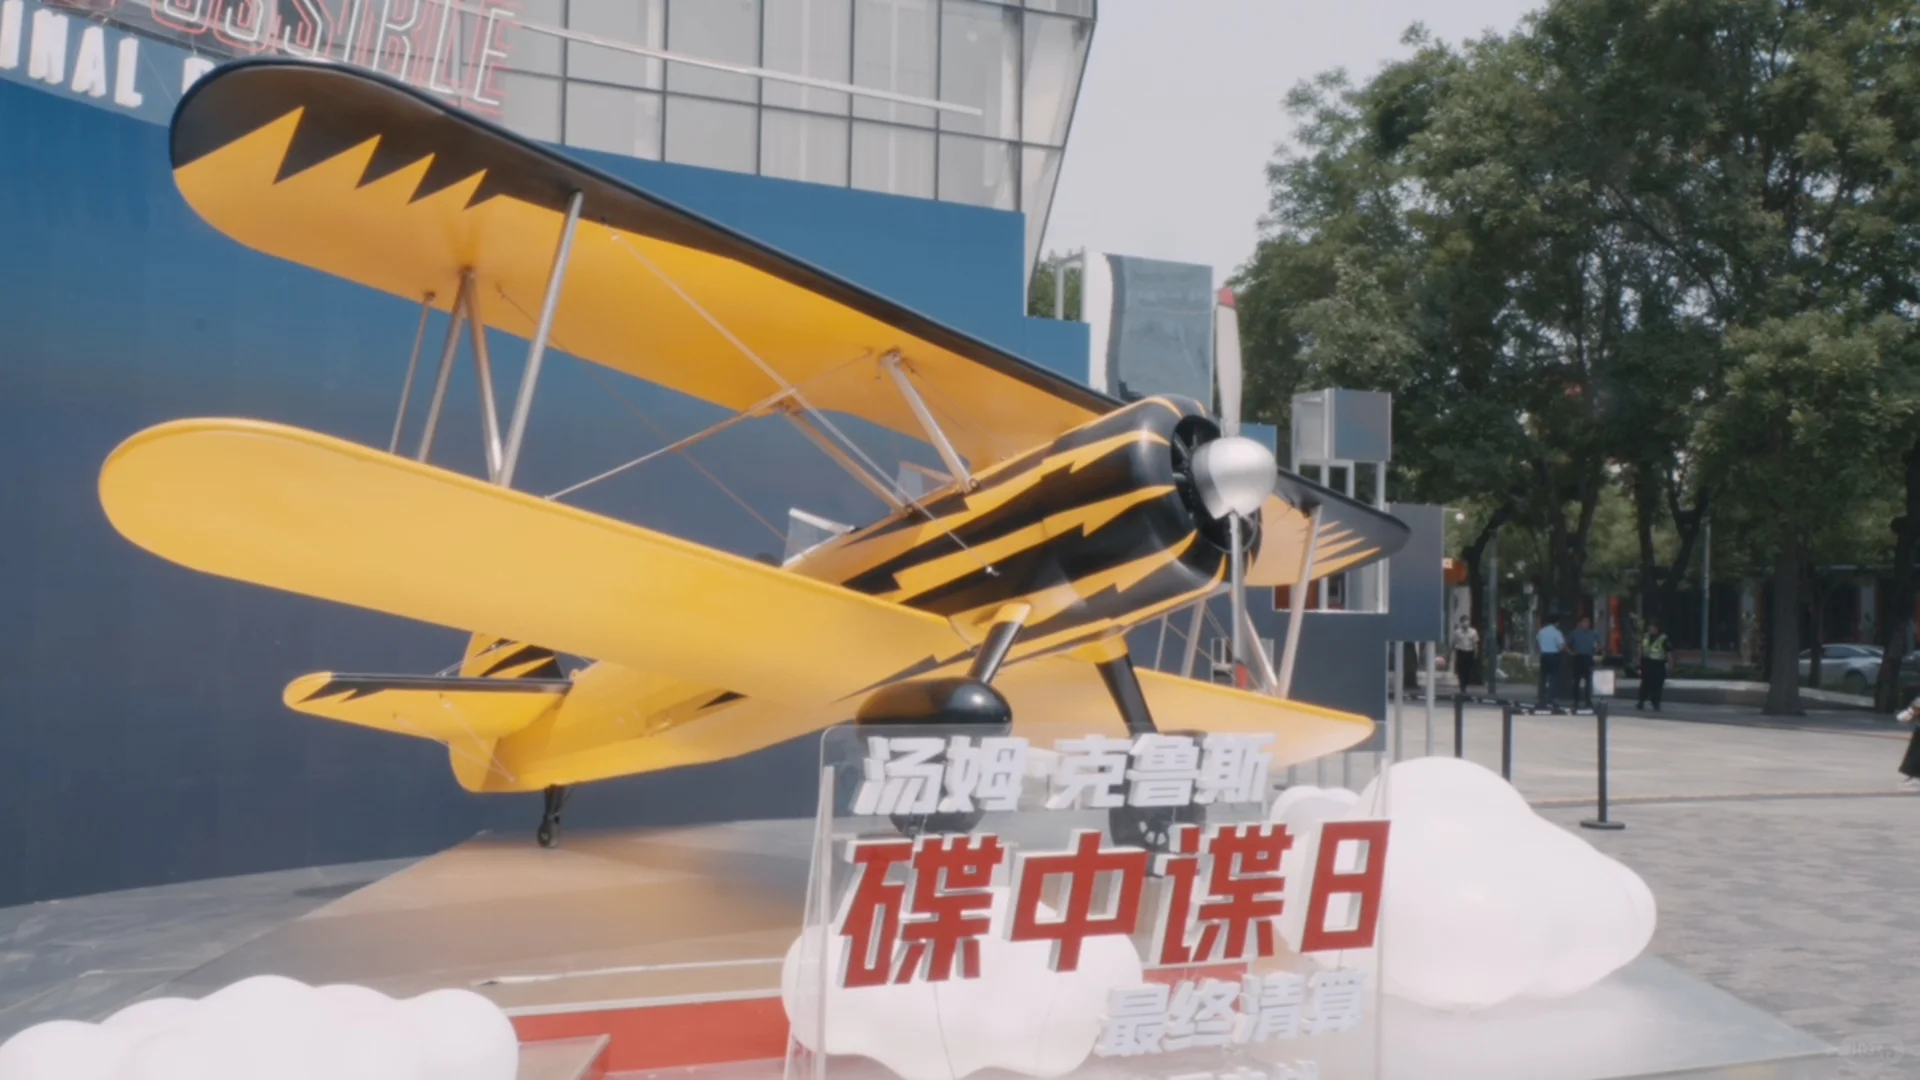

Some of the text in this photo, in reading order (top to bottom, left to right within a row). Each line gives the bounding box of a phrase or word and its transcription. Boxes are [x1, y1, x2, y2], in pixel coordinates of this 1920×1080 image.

[42, 0, 510, 116] SIBLE
[853, 734, 1277, 815] 汤姆 克鲁斯
[1094, 969, 1369, 1057] 最终清算
